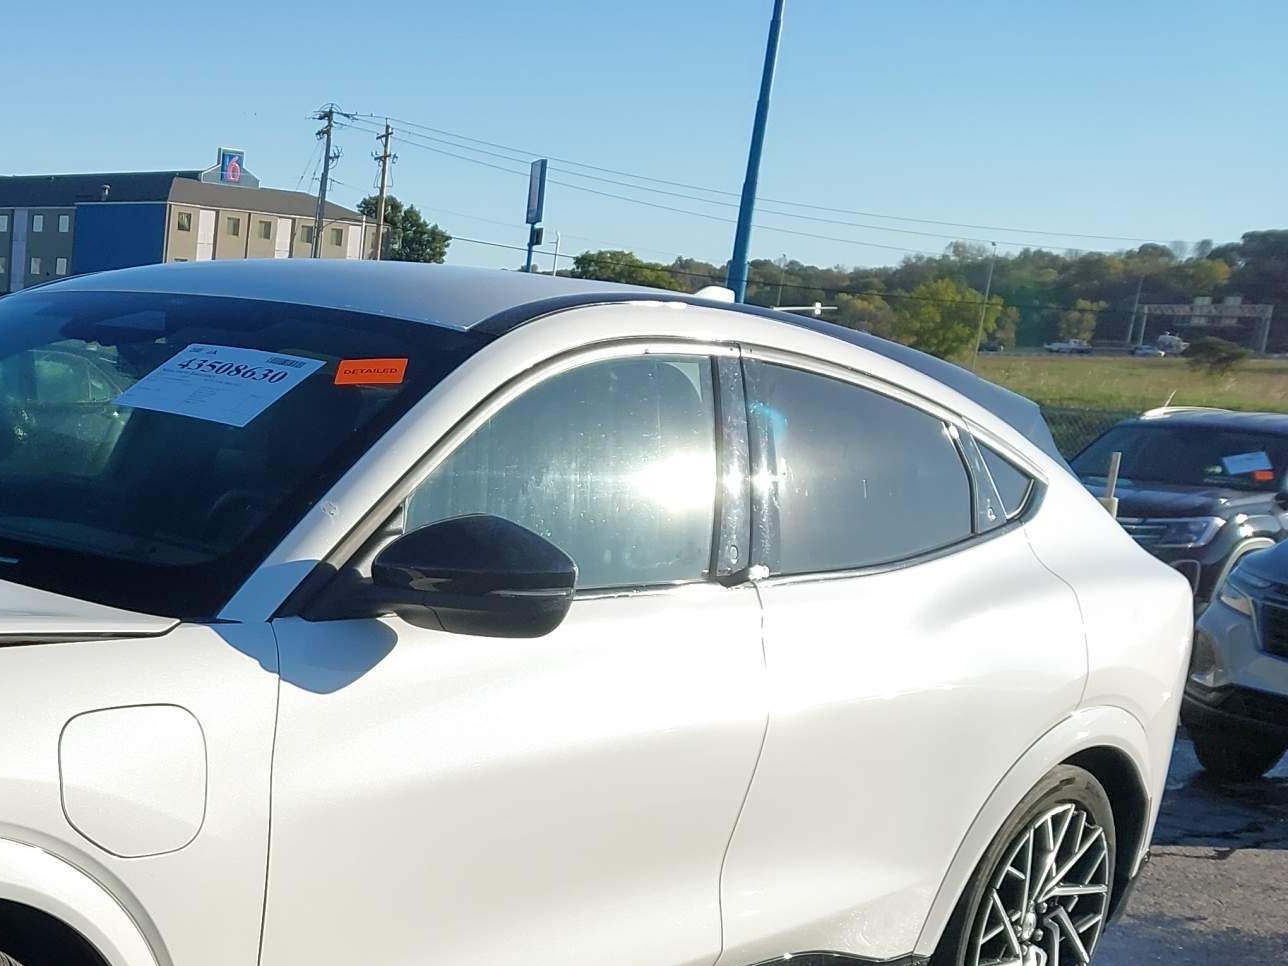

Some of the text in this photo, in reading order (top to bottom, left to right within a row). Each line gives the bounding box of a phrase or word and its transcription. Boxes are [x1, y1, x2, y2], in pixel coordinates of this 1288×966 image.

[227, 156, 241, 182] 6
[177, 358, 289, 384] 43508630
[343, 367, 398, 375] DETAILED
